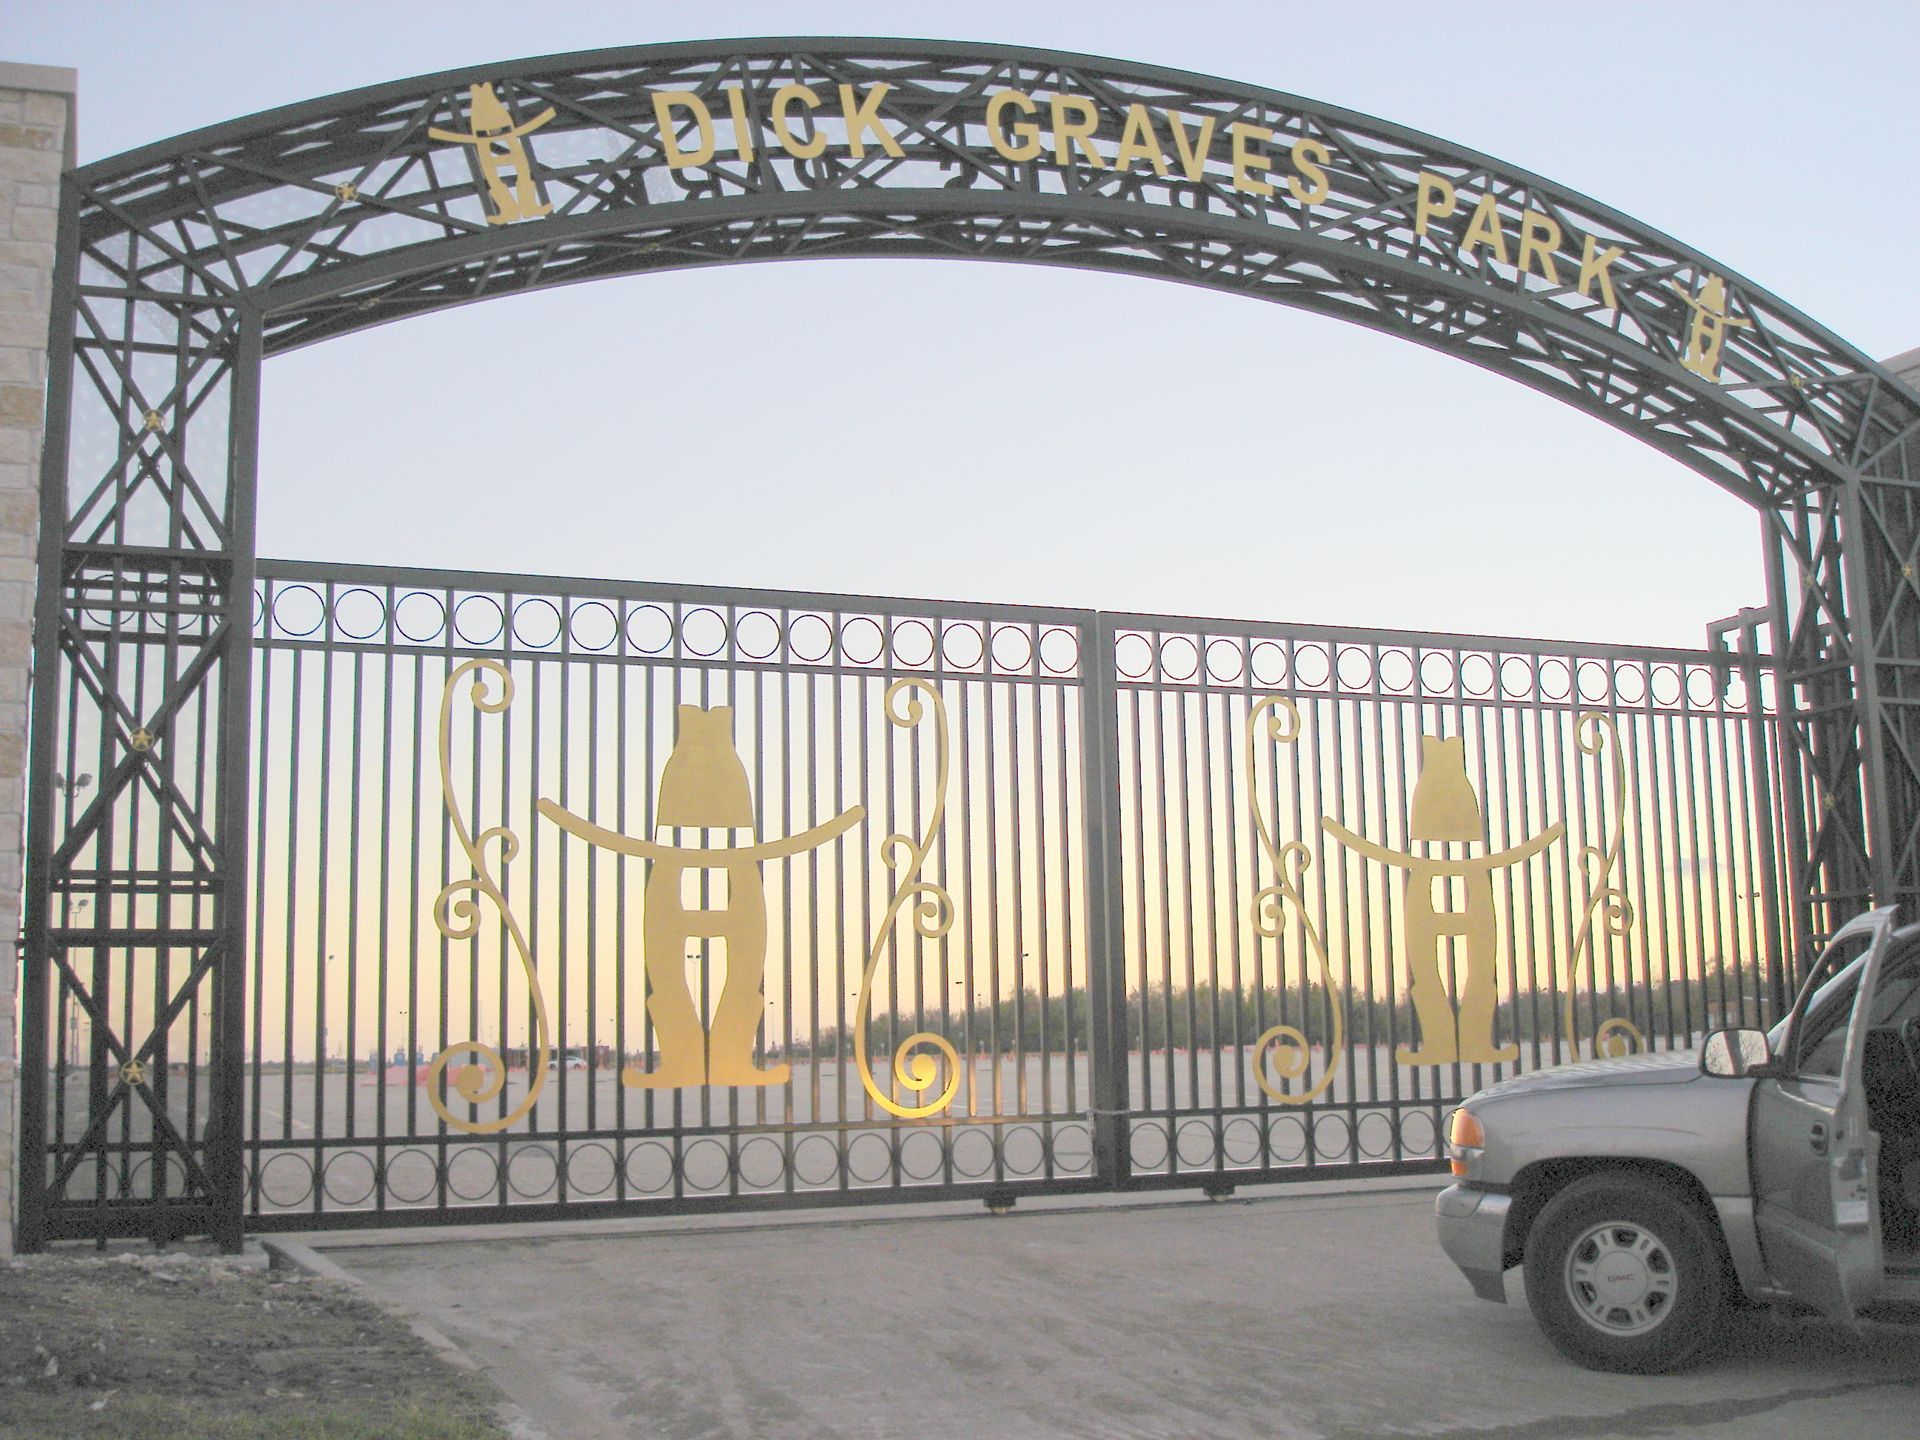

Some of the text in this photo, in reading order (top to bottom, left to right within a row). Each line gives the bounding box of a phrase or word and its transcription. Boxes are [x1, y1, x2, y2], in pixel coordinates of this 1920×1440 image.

[651, 83, 906, 169] DICK
[986, 90, 1331, 205] GRAVES
[1415, 171, 1624, 309] PARK
